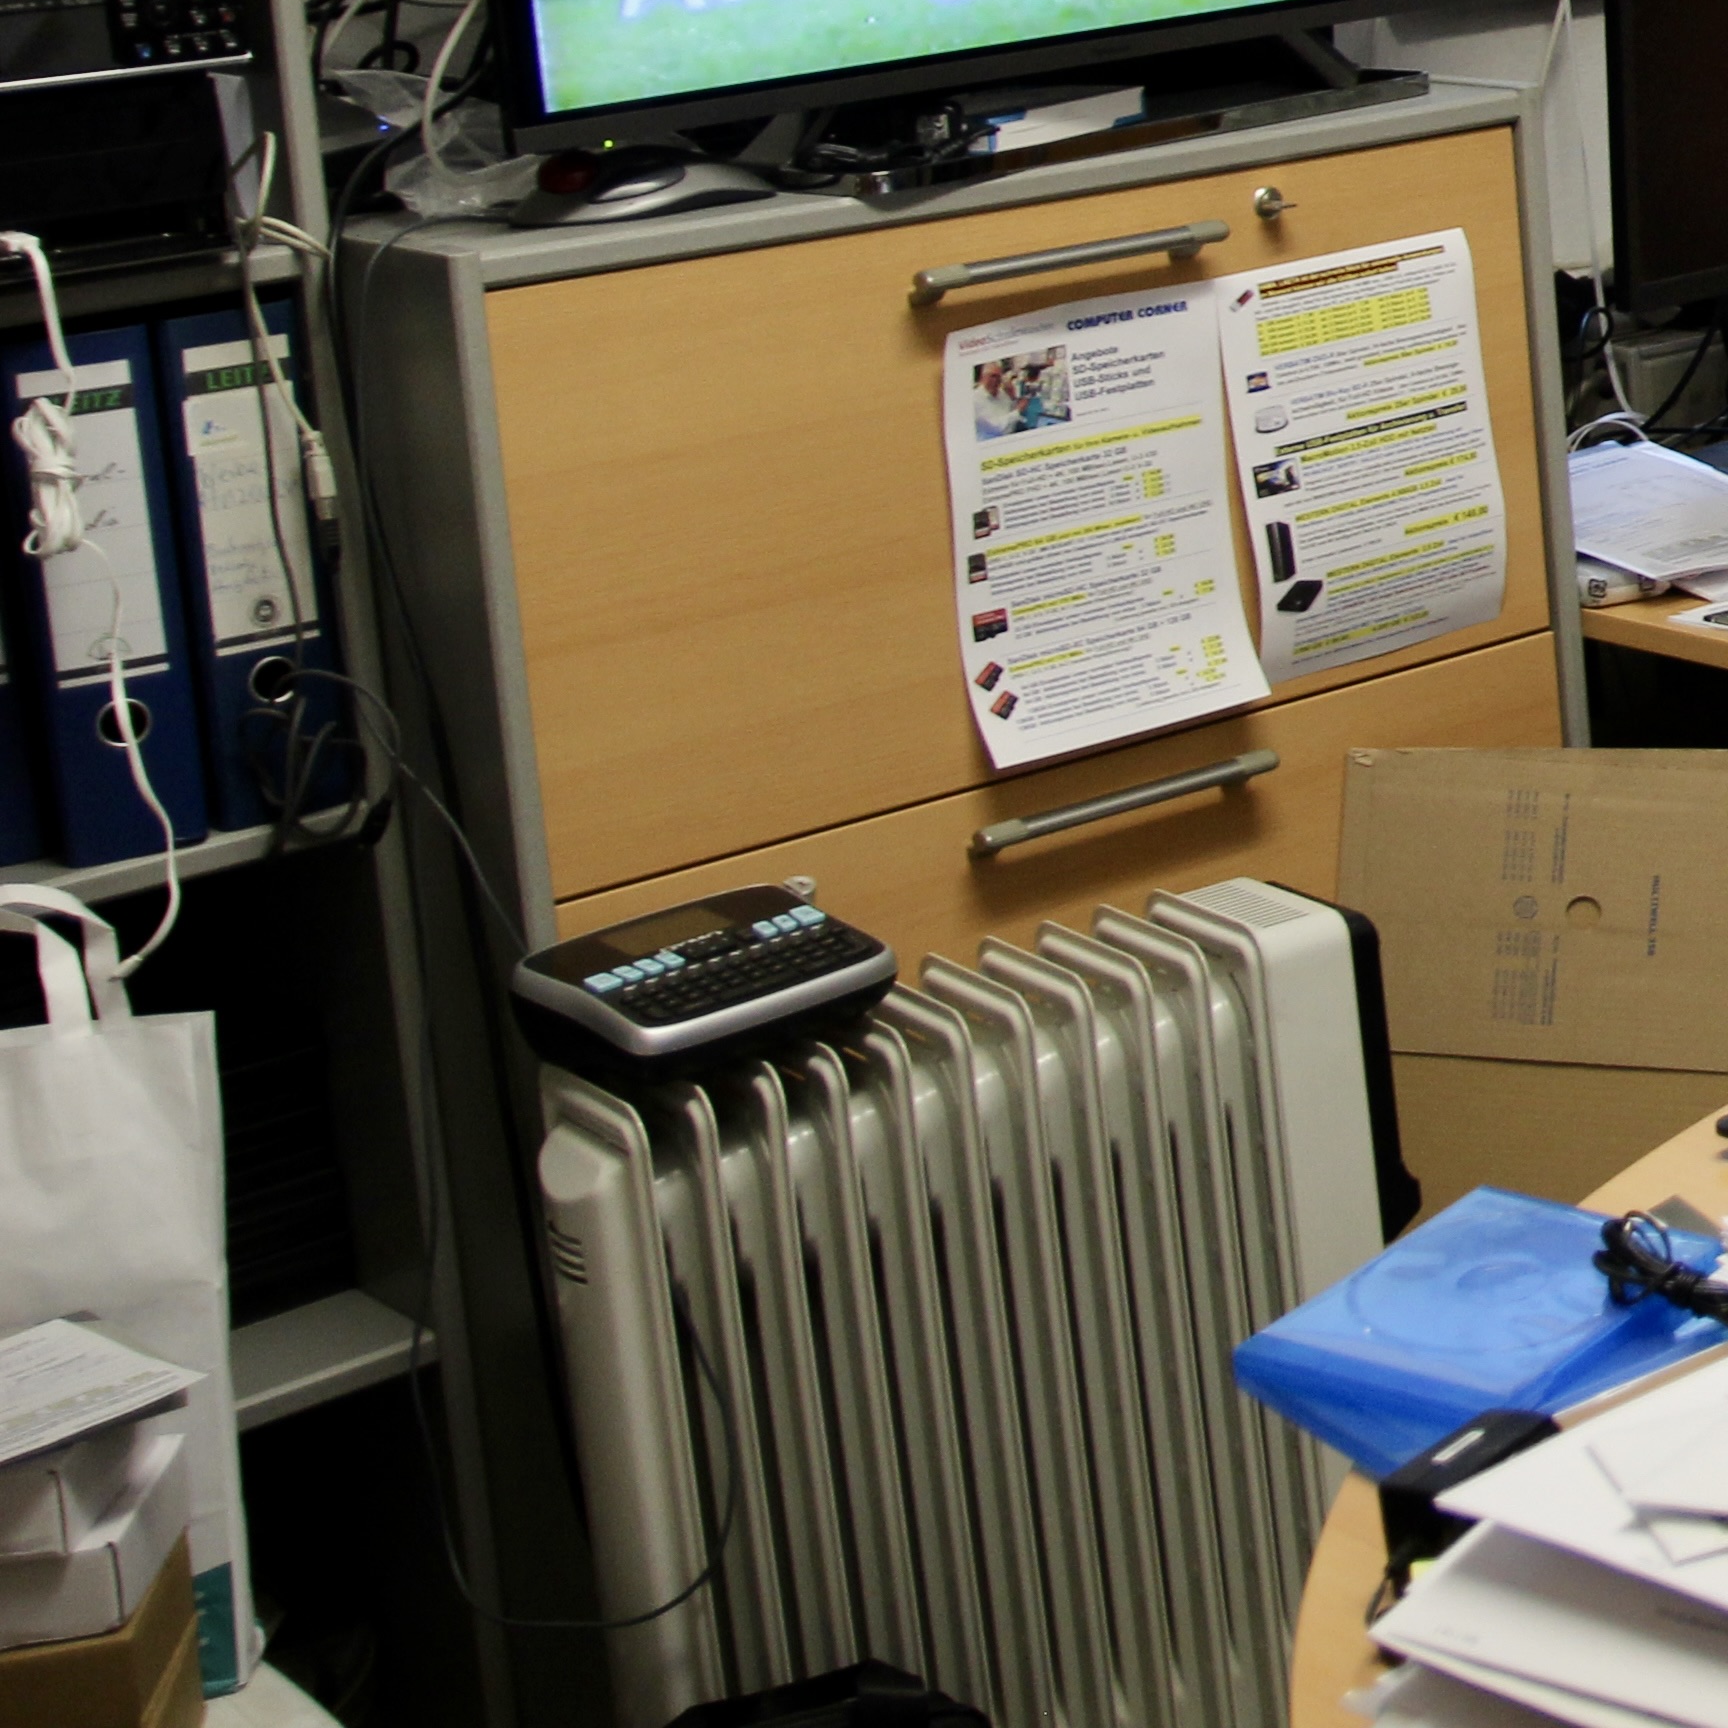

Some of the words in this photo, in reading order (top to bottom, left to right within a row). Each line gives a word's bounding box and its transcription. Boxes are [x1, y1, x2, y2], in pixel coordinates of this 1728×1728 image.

[1066, 308, 1135, 332] COMPUTER
[1137, 299, 1189, 319] CORNER
[1070, 345, 1119, 363] Angebote
